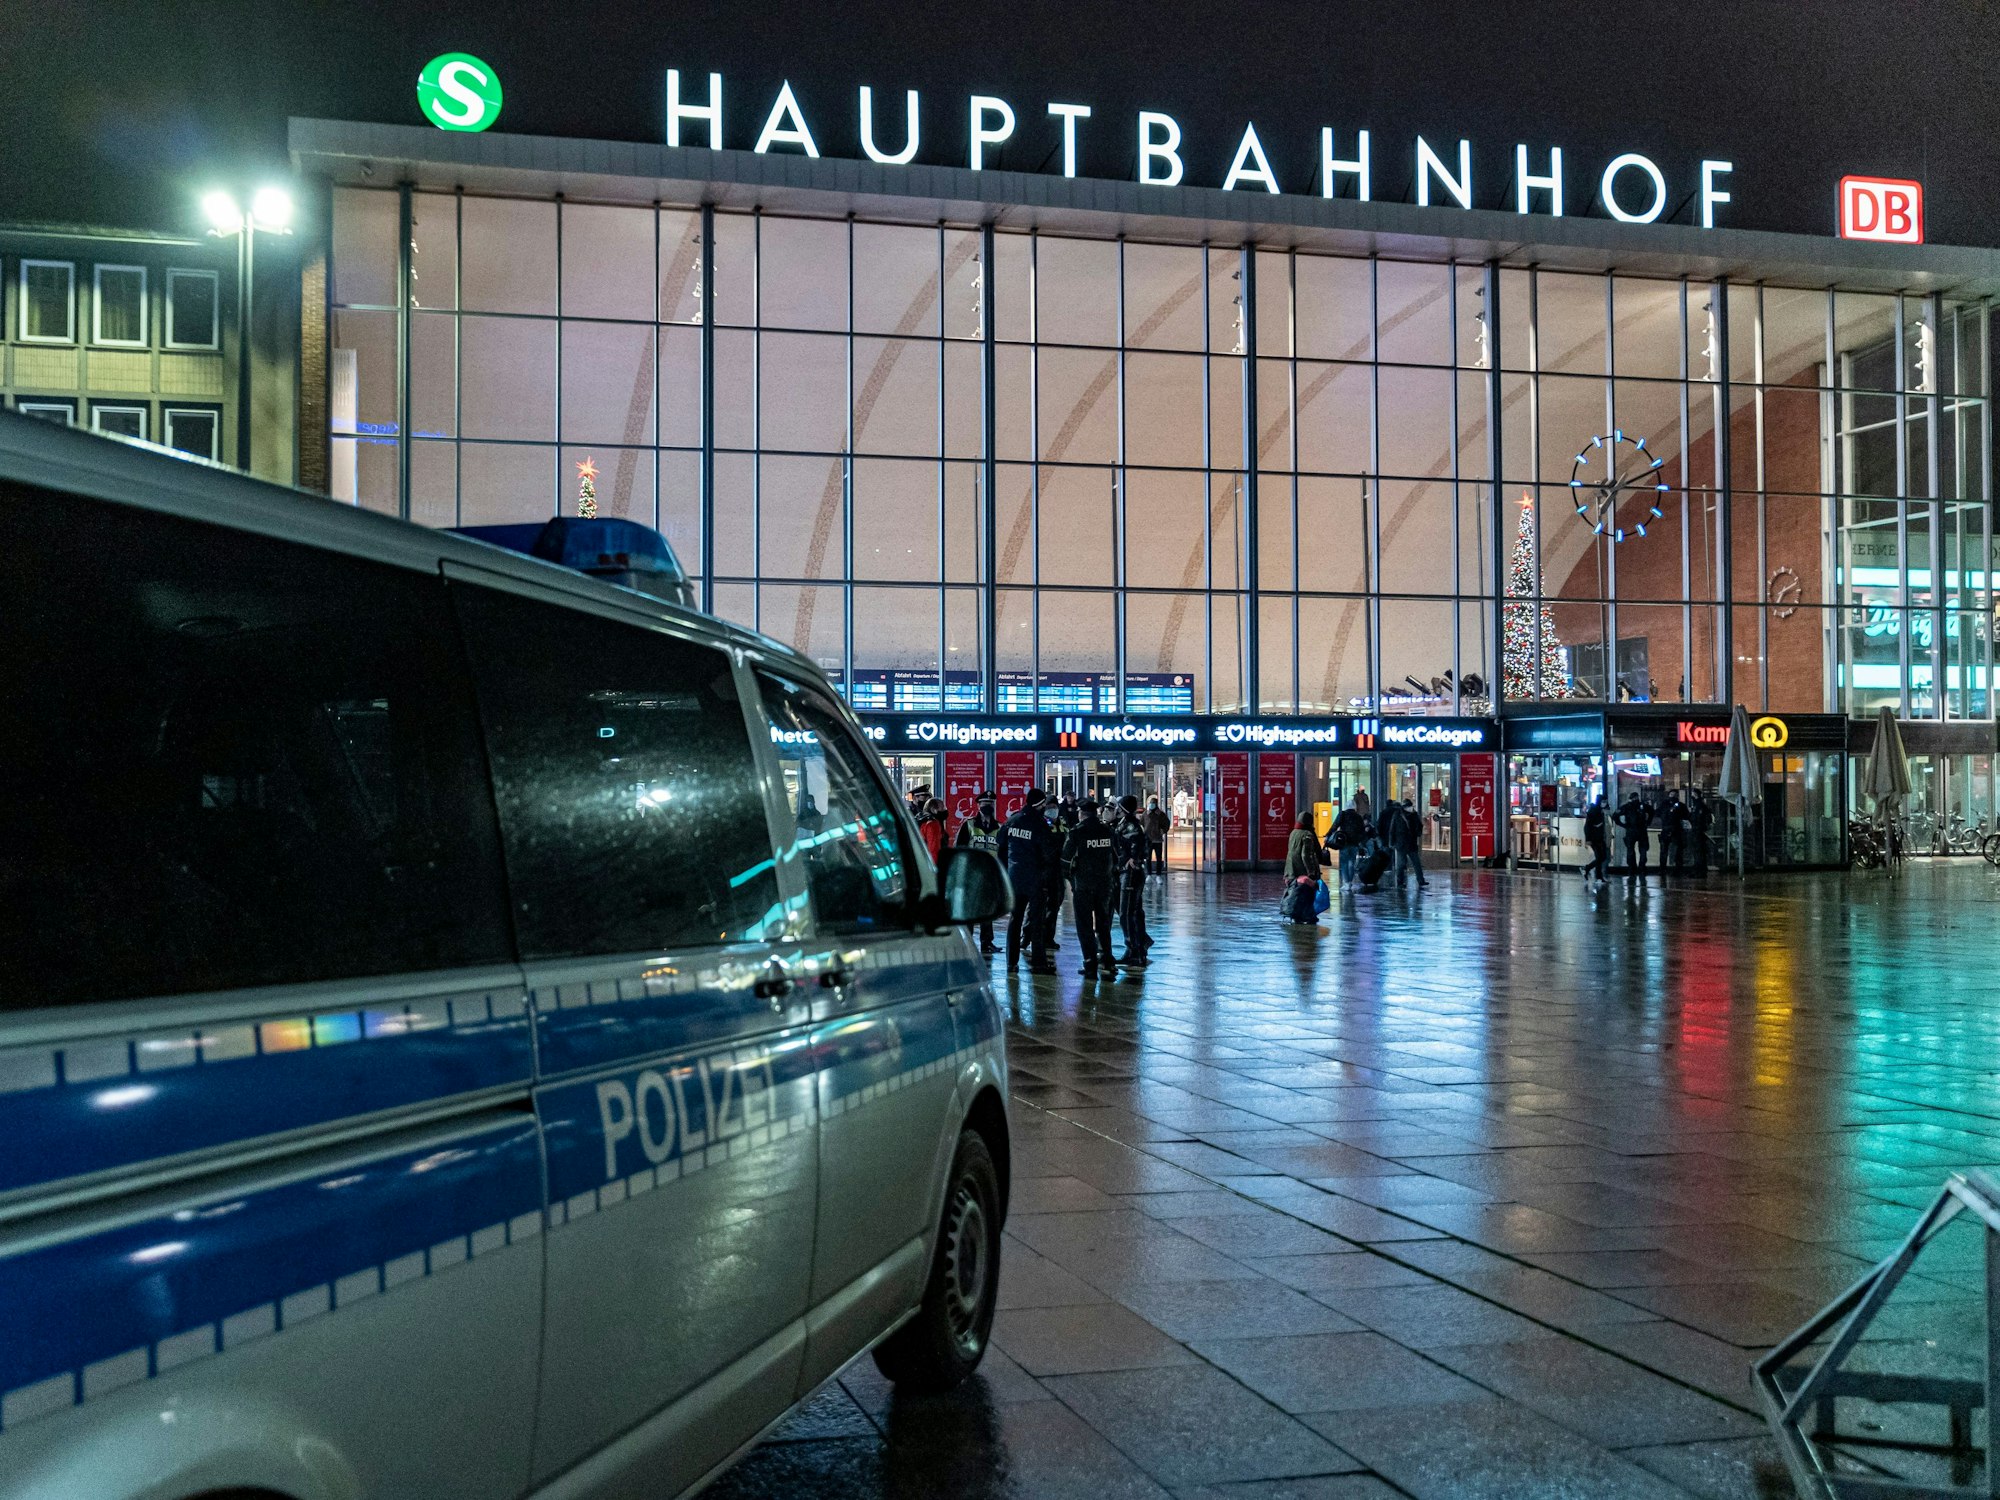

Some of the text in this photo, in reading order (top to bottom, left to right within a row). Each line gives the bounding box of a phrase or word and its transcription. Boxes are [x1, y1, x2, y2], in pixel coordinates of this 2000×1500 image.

[432, 60, 488, 127] S
[665, 68, 1734, 230] HAUPTBAHNHOF
[1851, 188, 1912, 235] DB
[939, 723, 1038, 744] Highspeed
[1089, 724, 1196, 745] NetCologne
[1245, 725, 1337, 746] Highspeed
[1384, 725, 1483, 746] NetCologne
[1007, 827, 1032, 840] POLIZEI
[1086, 838, 1111, 848] POLIZEI
[596, 1047, 776, 1178] POLIZEI
